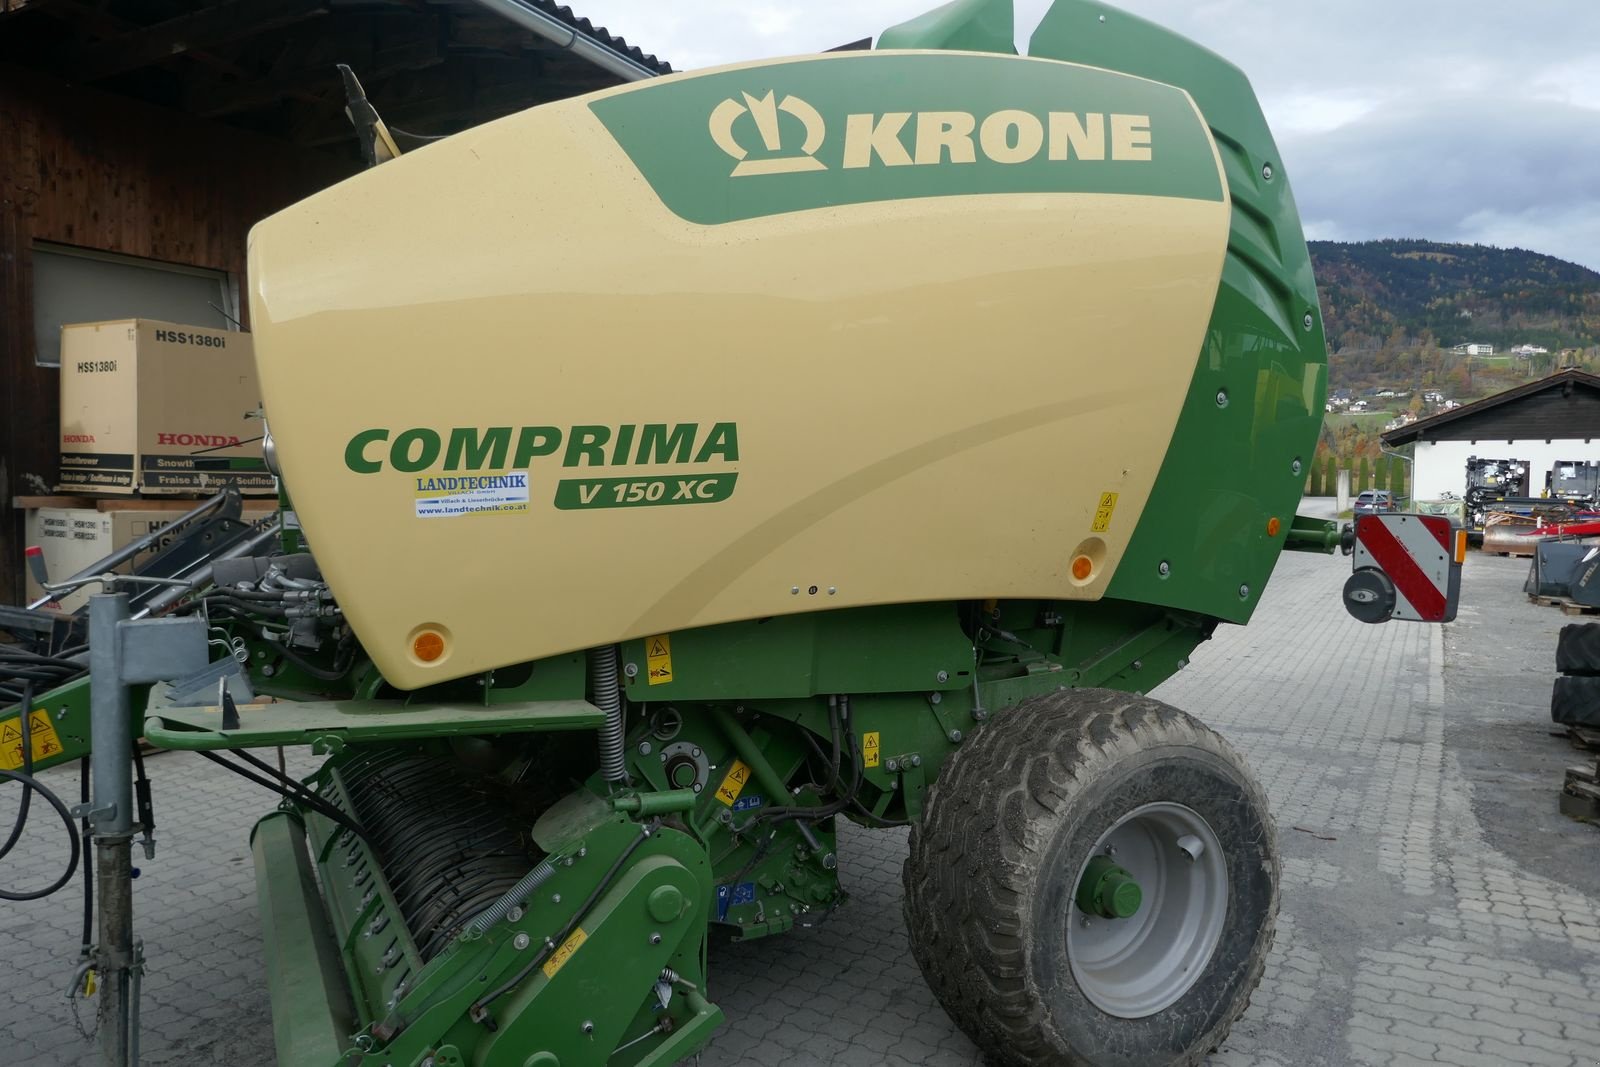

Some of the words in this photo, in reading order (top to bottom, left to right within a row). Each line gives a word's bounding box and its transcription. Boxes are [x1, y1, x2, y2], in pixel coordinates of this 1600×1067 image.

[842, 109, 1153, 169] KRONE
[156, 330, 226, 348] HSS1380i
[77, 360, 118, 374] HSS1380i
[63, 434, 96, 444] HONDA
[157, 432, 244, 448] HONDA
[344, 421, 740, 474] COMPRIMA
[159, 476, 191, 484] Fraise
[206, 477, 227, 487] eige
[416, 474, 527, 491] LANDTECHNIK
[579, 484, 602, 504] V
[612, 481, 666, 503] 150
[671, 478, 719, 501] XC
[418, 504, 527, 514] www.landtechnik.co.at
